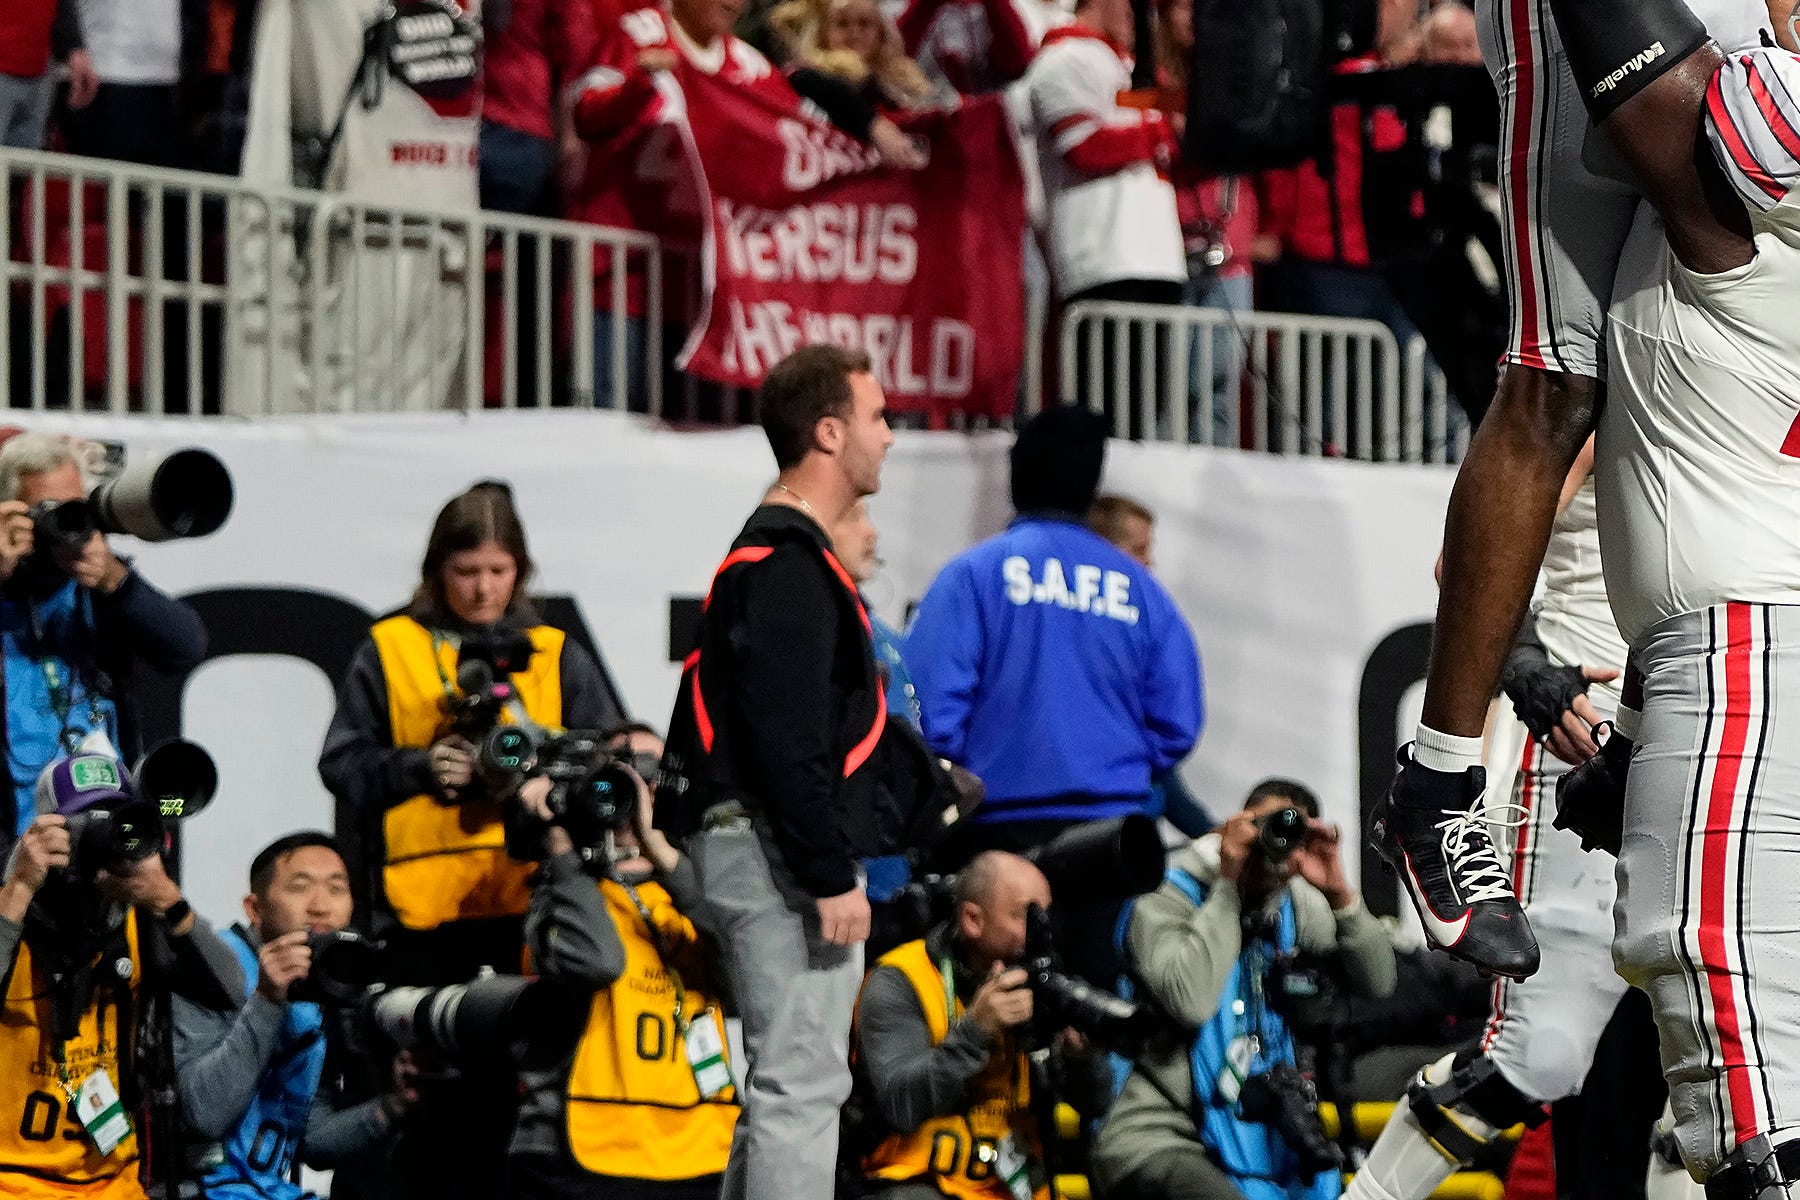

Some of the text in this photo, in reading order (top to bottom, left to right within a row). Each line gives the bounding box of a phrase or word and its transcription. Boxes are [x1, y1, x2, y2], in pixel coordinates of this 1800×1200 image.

[1592, 48, 1656, 99] Mueller
[717, 197, 919, 284] VERSUS
[1002, 555, 1141, 627] S.A.F.E.
